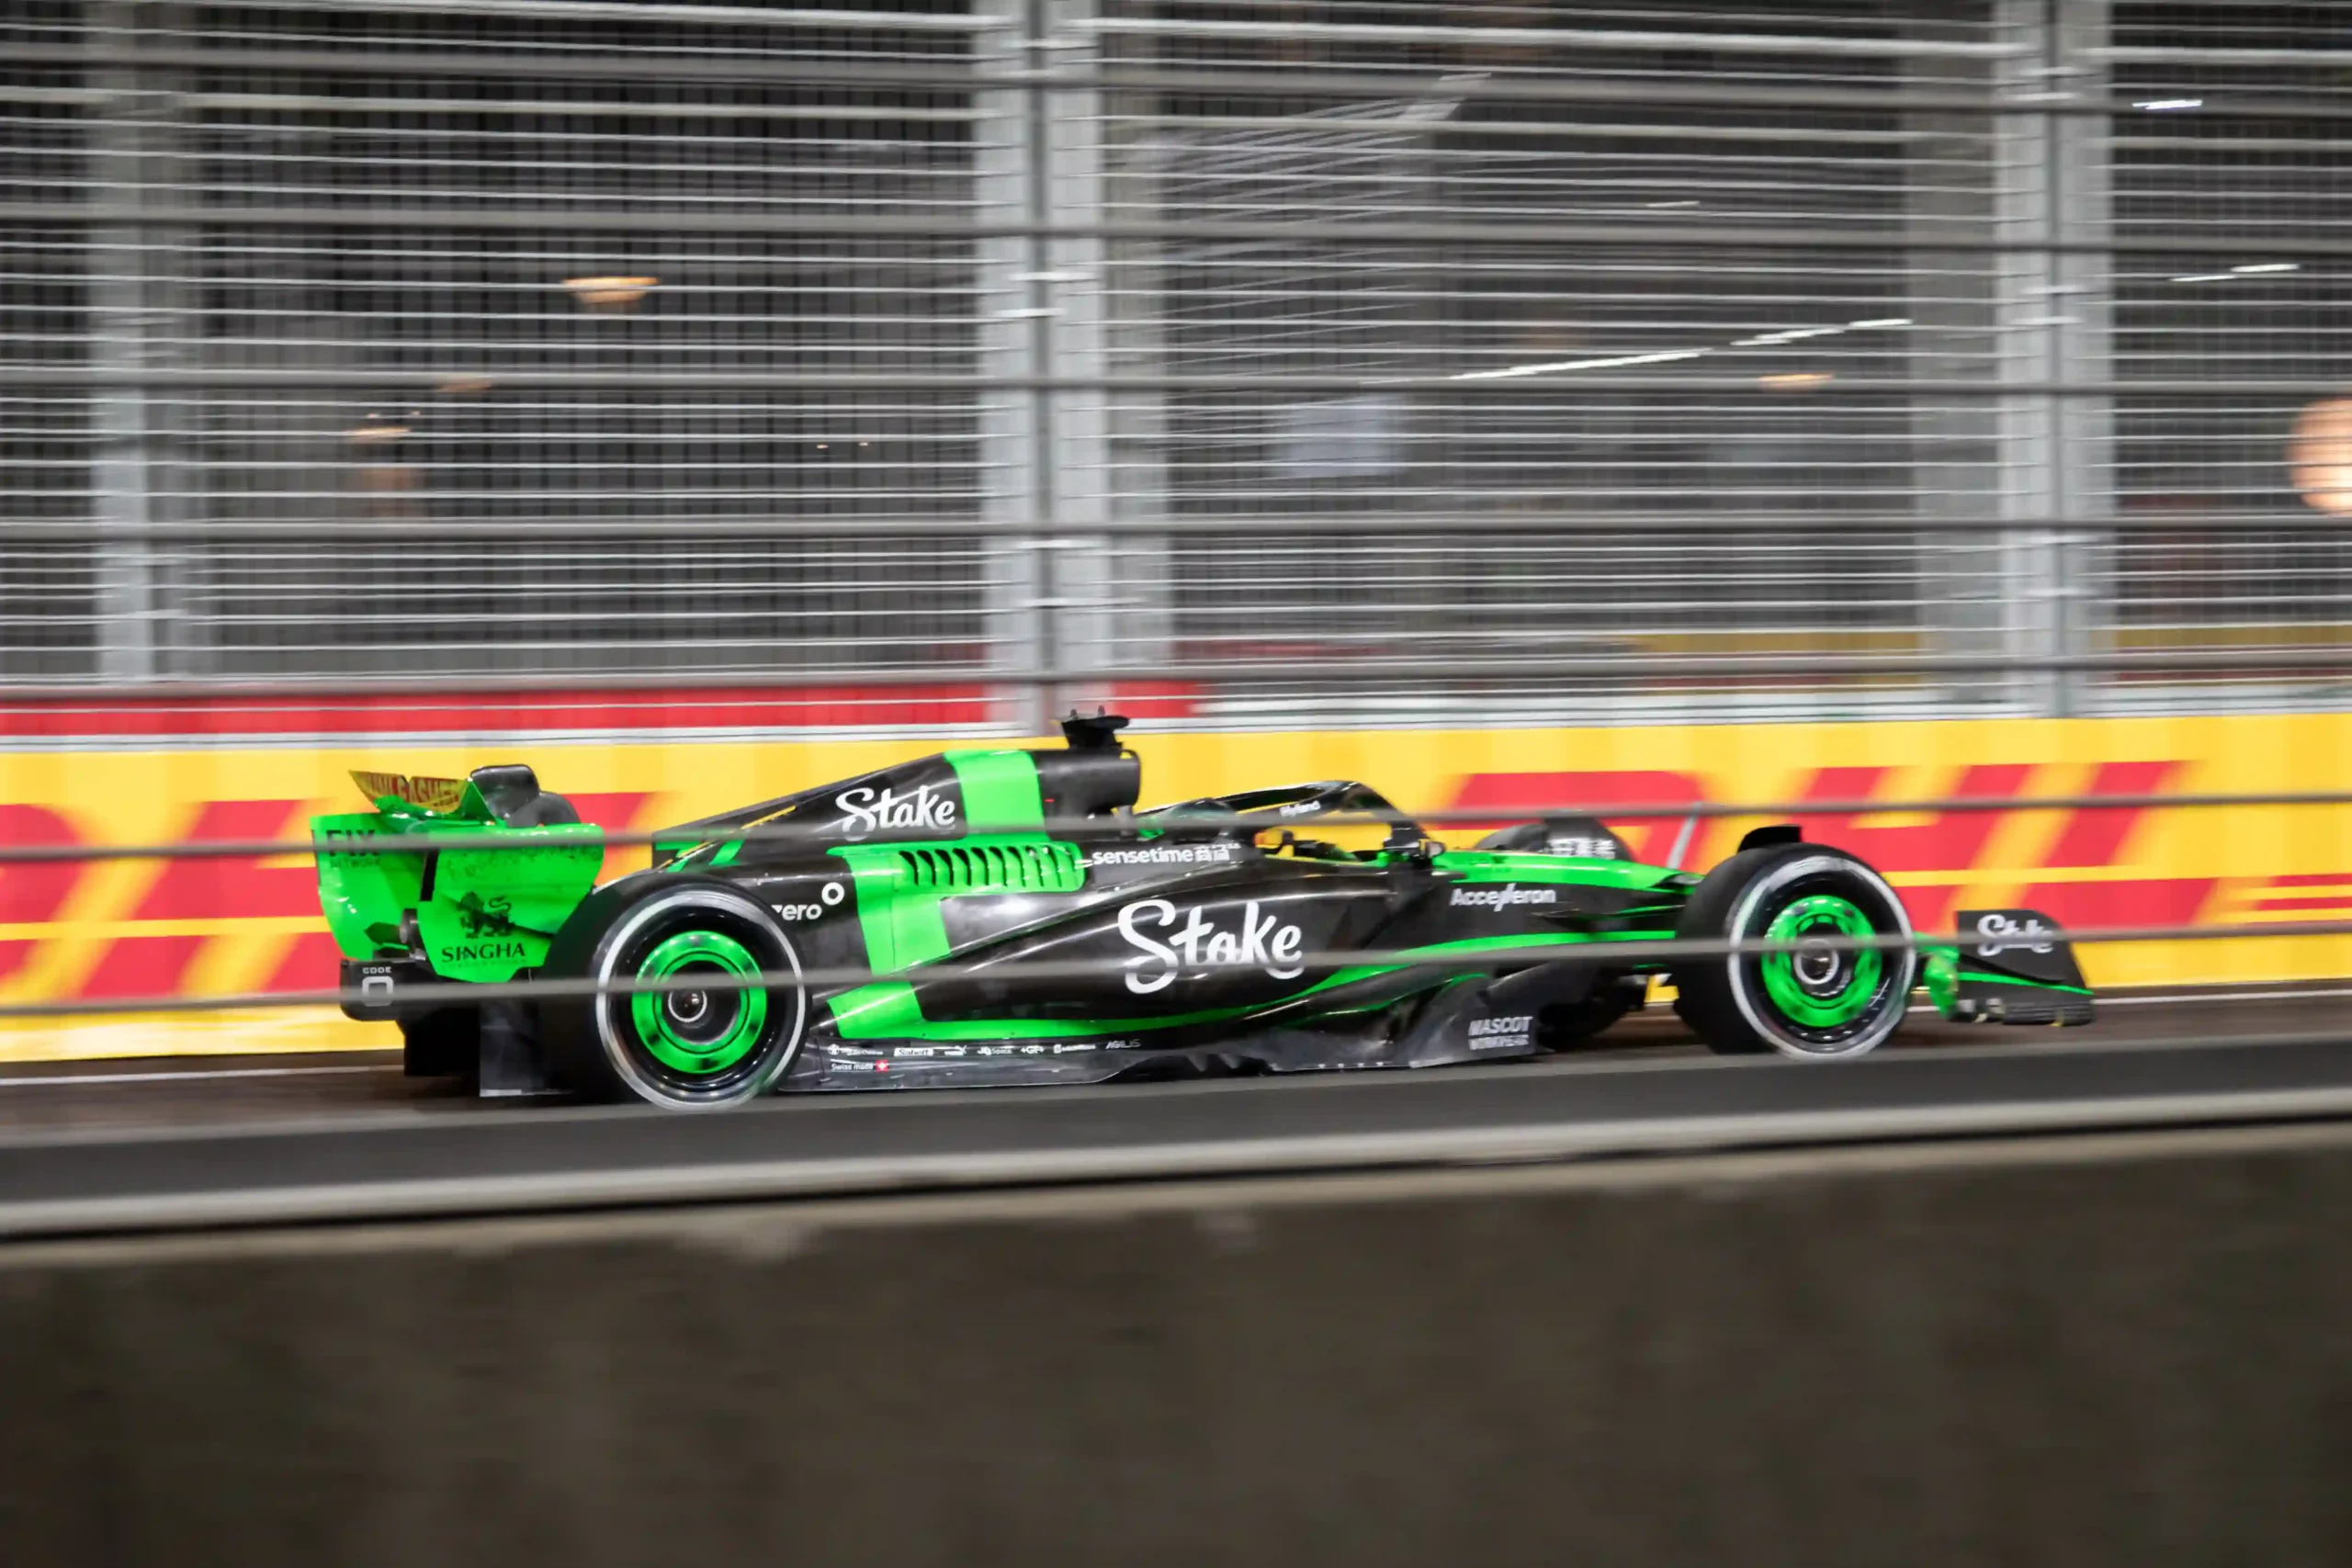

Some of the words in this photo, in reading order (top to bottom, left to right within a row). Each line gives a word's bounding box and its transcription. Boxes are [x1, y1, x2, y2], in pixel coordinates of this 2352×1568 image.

[835, 785, 956, 842] Stake
[1092, 846, 1194, 865] sensetime
[442, 942, 526, 964] SINGHA
[1118, 898, 1306, 994] Stake
[362, 966, 392, 975] CODE
[1467, 1016, 1533, 1036] MASCOT
[831, 1062, 852, 1071] Swiss
